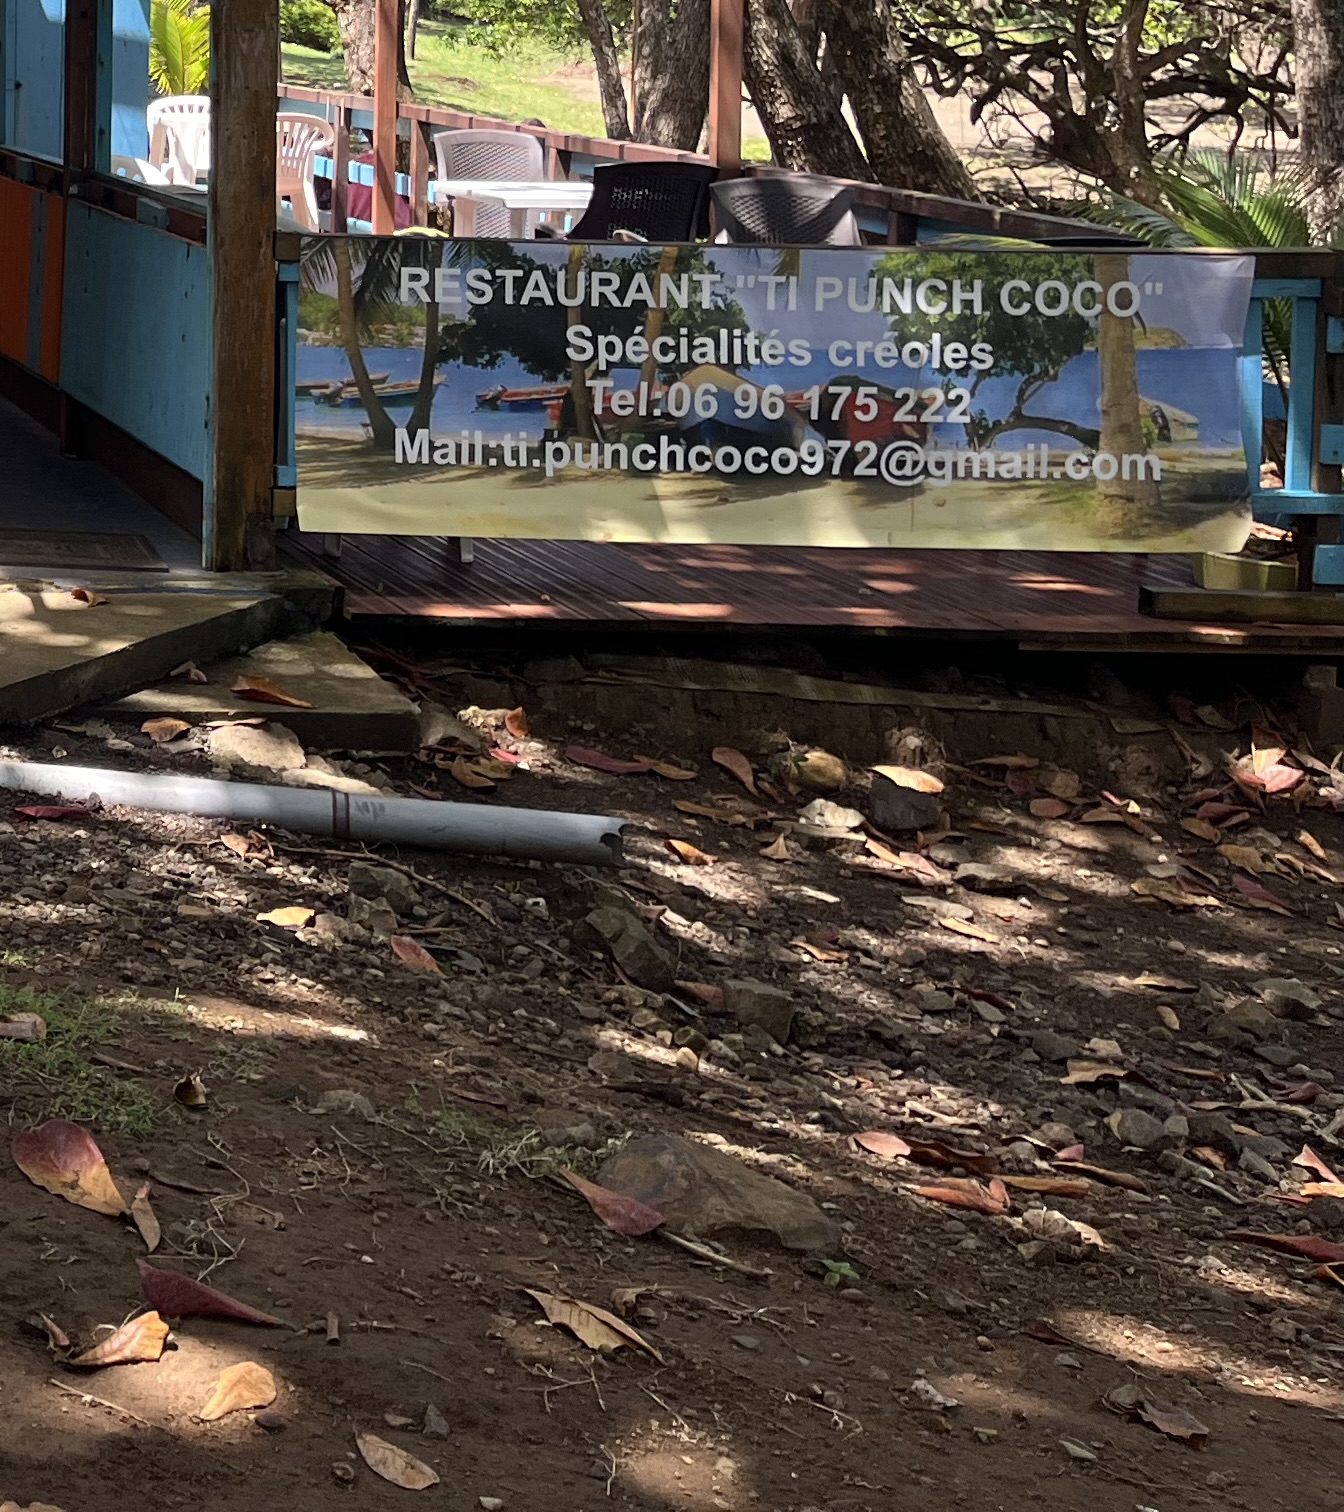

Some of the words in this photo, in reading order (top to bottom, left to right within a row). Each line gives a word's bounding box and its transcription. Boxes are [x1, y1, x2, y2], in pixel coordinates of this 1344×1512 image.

[398, 265, 720, 312] RESTAURANT
[814, 275, 984, 317] PUNCH
[564, 322, 812, 370] Spécialités
[827, 333, 995, 373] créoles
[732, 383, 786, 424] 96
[805, 386, 881, 425] 175
[892, 387, 973, 427] 222
[392, 426, 1163, 487] Mail:ti.punchcoco972@gmail.com
